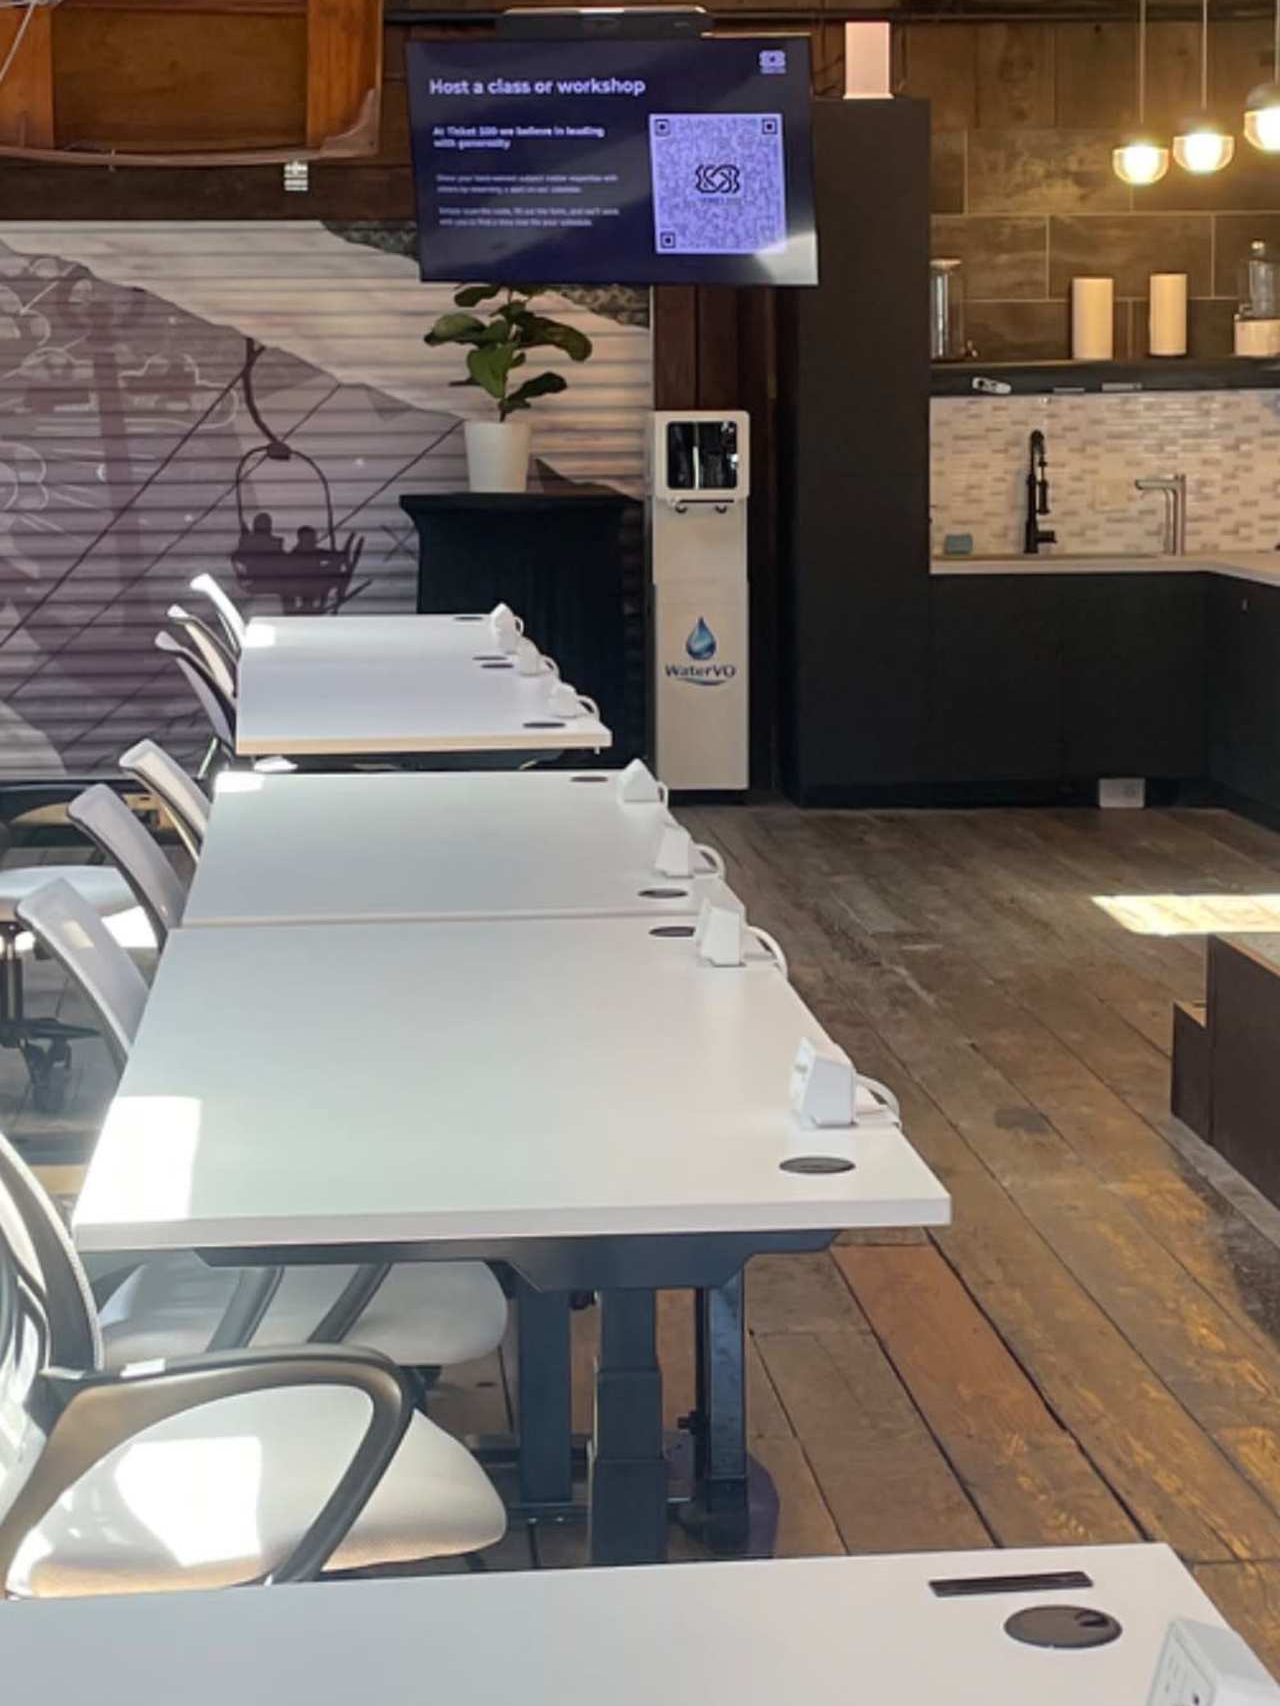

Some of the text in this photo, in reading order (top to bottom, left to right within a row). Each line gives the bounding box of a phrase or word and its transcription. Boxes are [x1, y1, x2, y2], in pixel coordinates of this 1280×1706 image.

[429, 78, 646, 96] Host a class or workshop
[447, 126, 476, 136] Ticket
[500, 128, 514, 136] we
[516, 126, 552, 136] believe
[553, 126, 564, 136] in
[566, 126, 605, 138] leading
